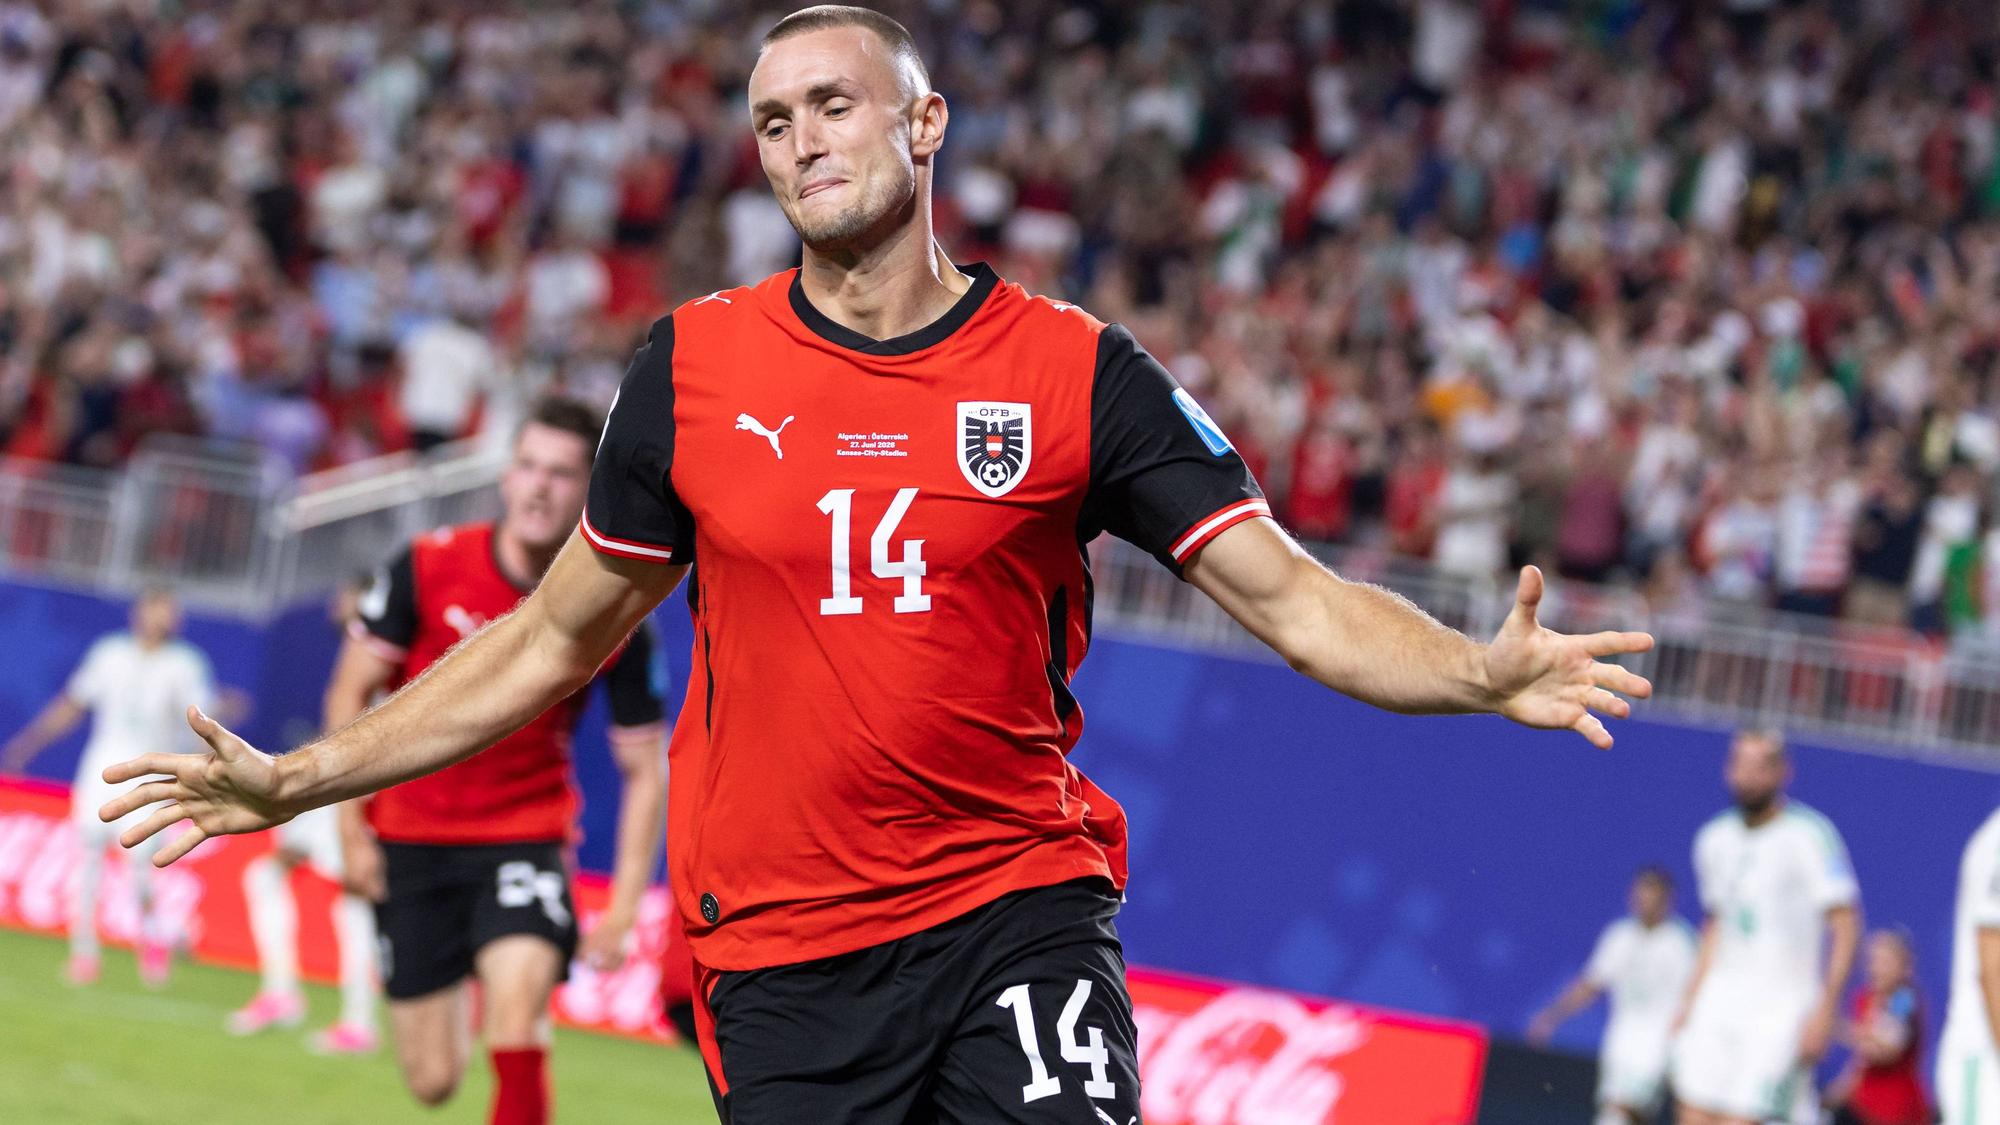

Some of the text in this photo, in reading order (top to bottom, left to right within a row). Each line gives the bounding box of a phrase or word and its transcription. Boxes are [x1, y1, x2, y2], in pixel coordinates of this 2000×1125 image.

[979, 406, 1010, 417] ÖFB
[871, 432, 909, 440] Österreich
[836, 449, 908, 457] Kansas-City-Stadion
[815, 487, 932, 615] 14
[995, 979, 1116, 1103] 14
